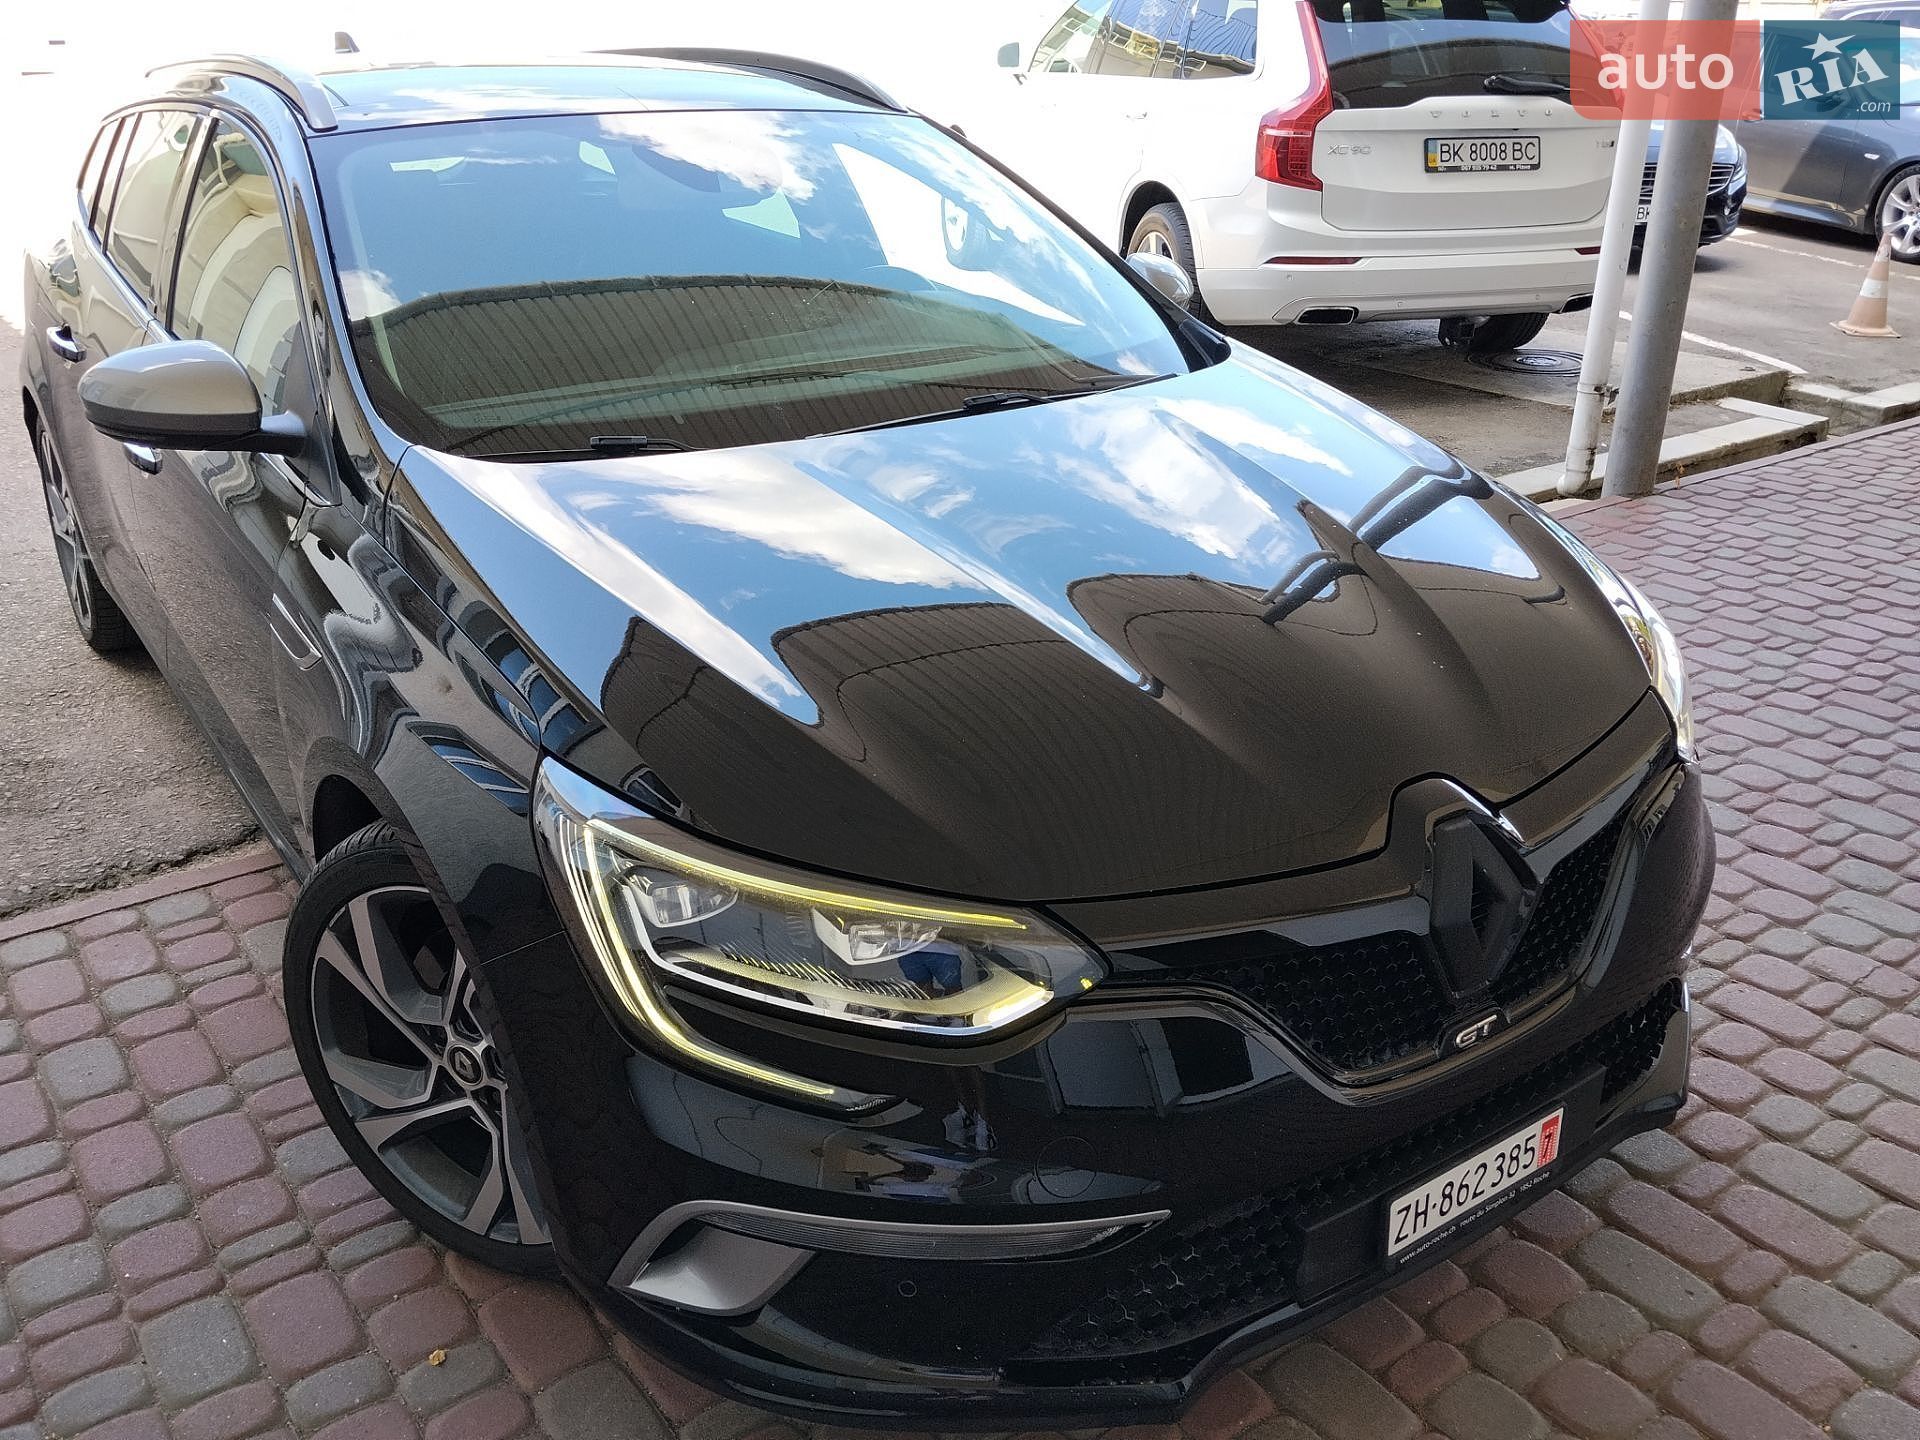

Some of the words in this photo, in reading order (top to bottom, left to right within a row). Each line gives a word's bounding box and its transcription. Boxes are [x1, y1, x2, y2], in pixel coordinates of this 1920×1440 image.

[1440, 143, 1464, 163] BK
[1469, 142, 1507, 161] 8008
[1512, 142, 1536, 161] BC
[1455, 1014, 1498, 1049] GT
